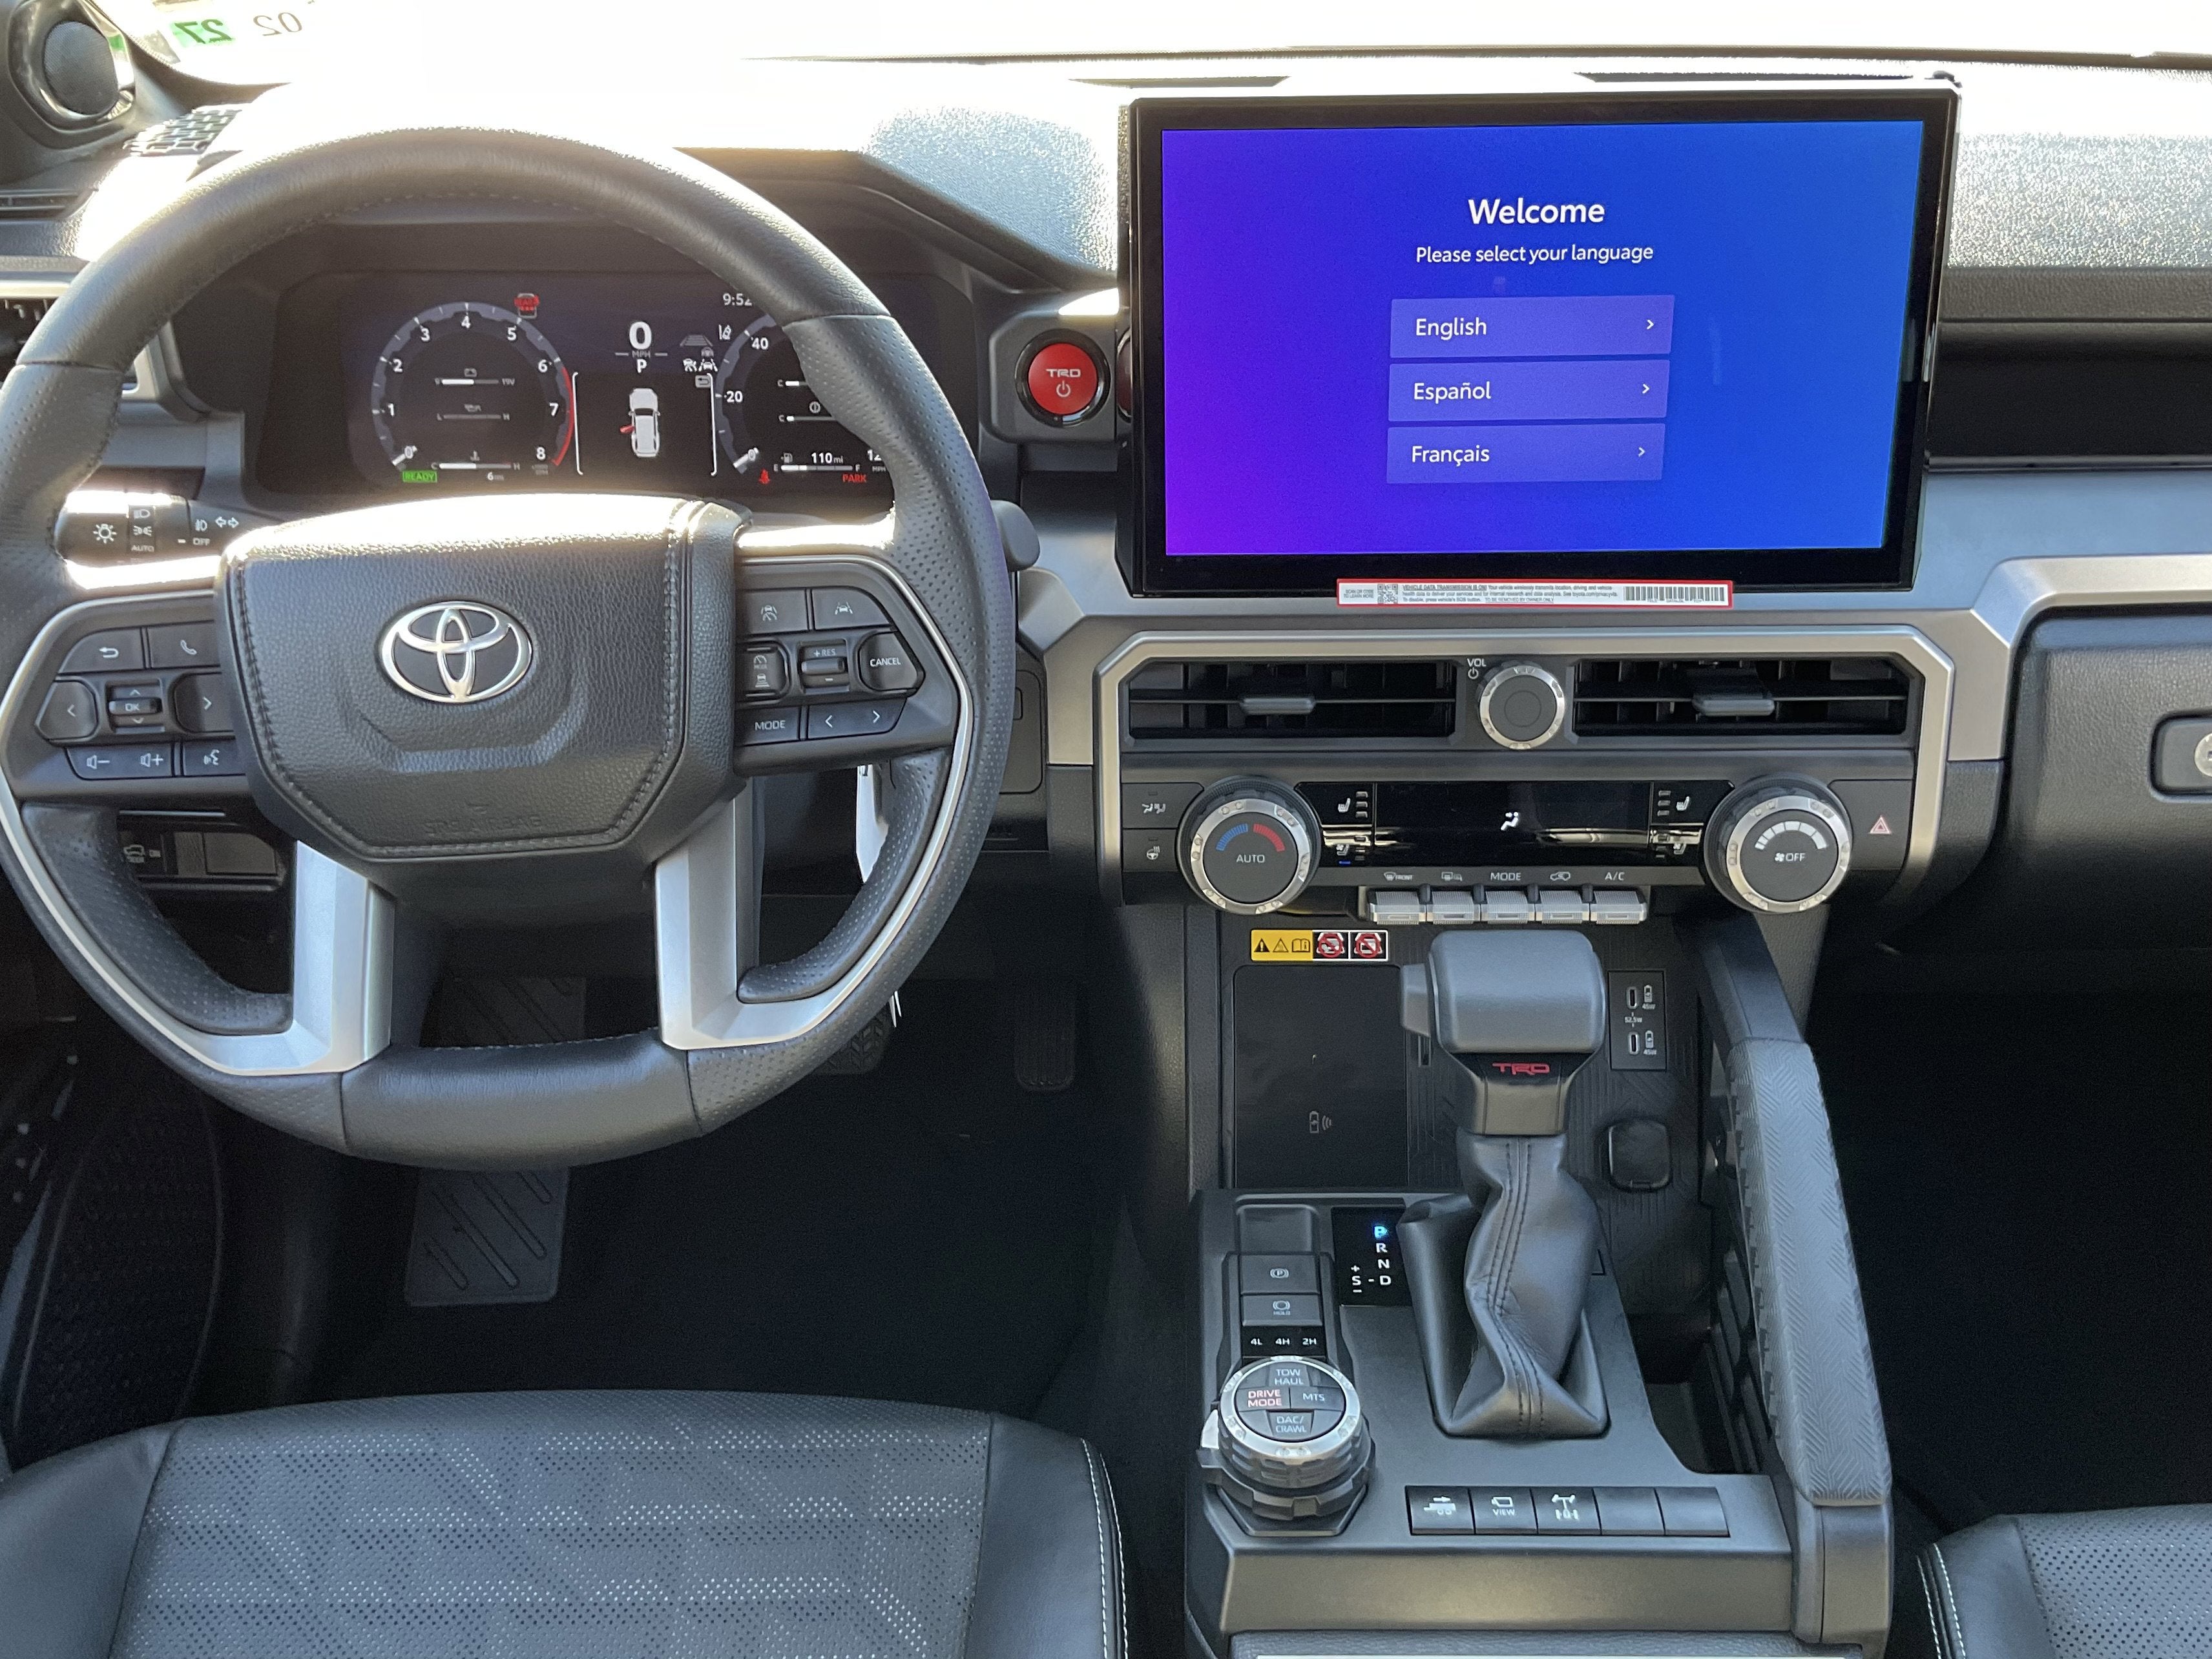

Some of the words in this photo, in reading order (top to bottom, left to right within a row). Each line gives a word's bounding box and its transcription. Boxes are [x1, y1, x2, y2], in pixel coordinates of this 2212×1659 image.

[1468, 198, 1606, 225] Welcome
[1416, 246, 1472, 263] Please
[1475, 245, 1526, 262] select
[1529, 247, 1567, 265] your
[1571, 244, 1654, 264] language
[461, 316, 471, 328] 4
[1415, 317, 1488, 340] English
[421, 328, 431, 341] 3
[506, 328, 517, 341] 5
[629, 321, 652, 350] 0
[751, 337, 769, 350] 40
[393, 359, 403, 372] 2
[537, 360, 548, 373] 6
[637, 359, 647, 373] P
[1046, 368, 1081, 378] TRD
[726, 390, 743, 403] 20
[1414, 382, 1491, 404] Español
[388, 403, 395, 417] 1
[549, 402, 559, 416] 7
[536, 446, 546, 460] 8
[1411, 445, 1490, 466] Français
[404, 472, 435, 481] READY
[842, 474, 867, 483] PARK
[870, 656, 901, 667] CANCEL
[1467, 658, 1487, 667] VOL
[125, 702, 140, 712] OK
[755, 720, 786, 731] MODE
[1236, 854, 1266, 864] AUTO
[1785, 853, 1806, 862] OFF
[1490, 871, 1521, 882] MODE
[1604, 871, 1625, 882] A/C
[1492, 1063, 1550, 1076] TRD
[1373, 1225, 1388, 1239] P
[1375, 1242, 1388, 1253] R
[1378, 1258, 1390, 1269] N
[1379, 1275, 1392, 1286] D
[1251, 1337, 1263, 1346] 4L
[1275, 1337, 1290, 1346] 4H
[1302, 1337, 1317, 1346] 2H
[1276, 1368, 1301, 1377] TOW
[1275, 1377, 1304, 1385] HAUL
[1247, 1389, 1281, 1399] DRIVE
[1302, 1393, 1325, 1401] MTS
[1247, 1398, 1282, 1408] MODE
[1276, 1415, 1304, 1424] DAC/
[1275, 1424, 1307, 1433] CRAWL
